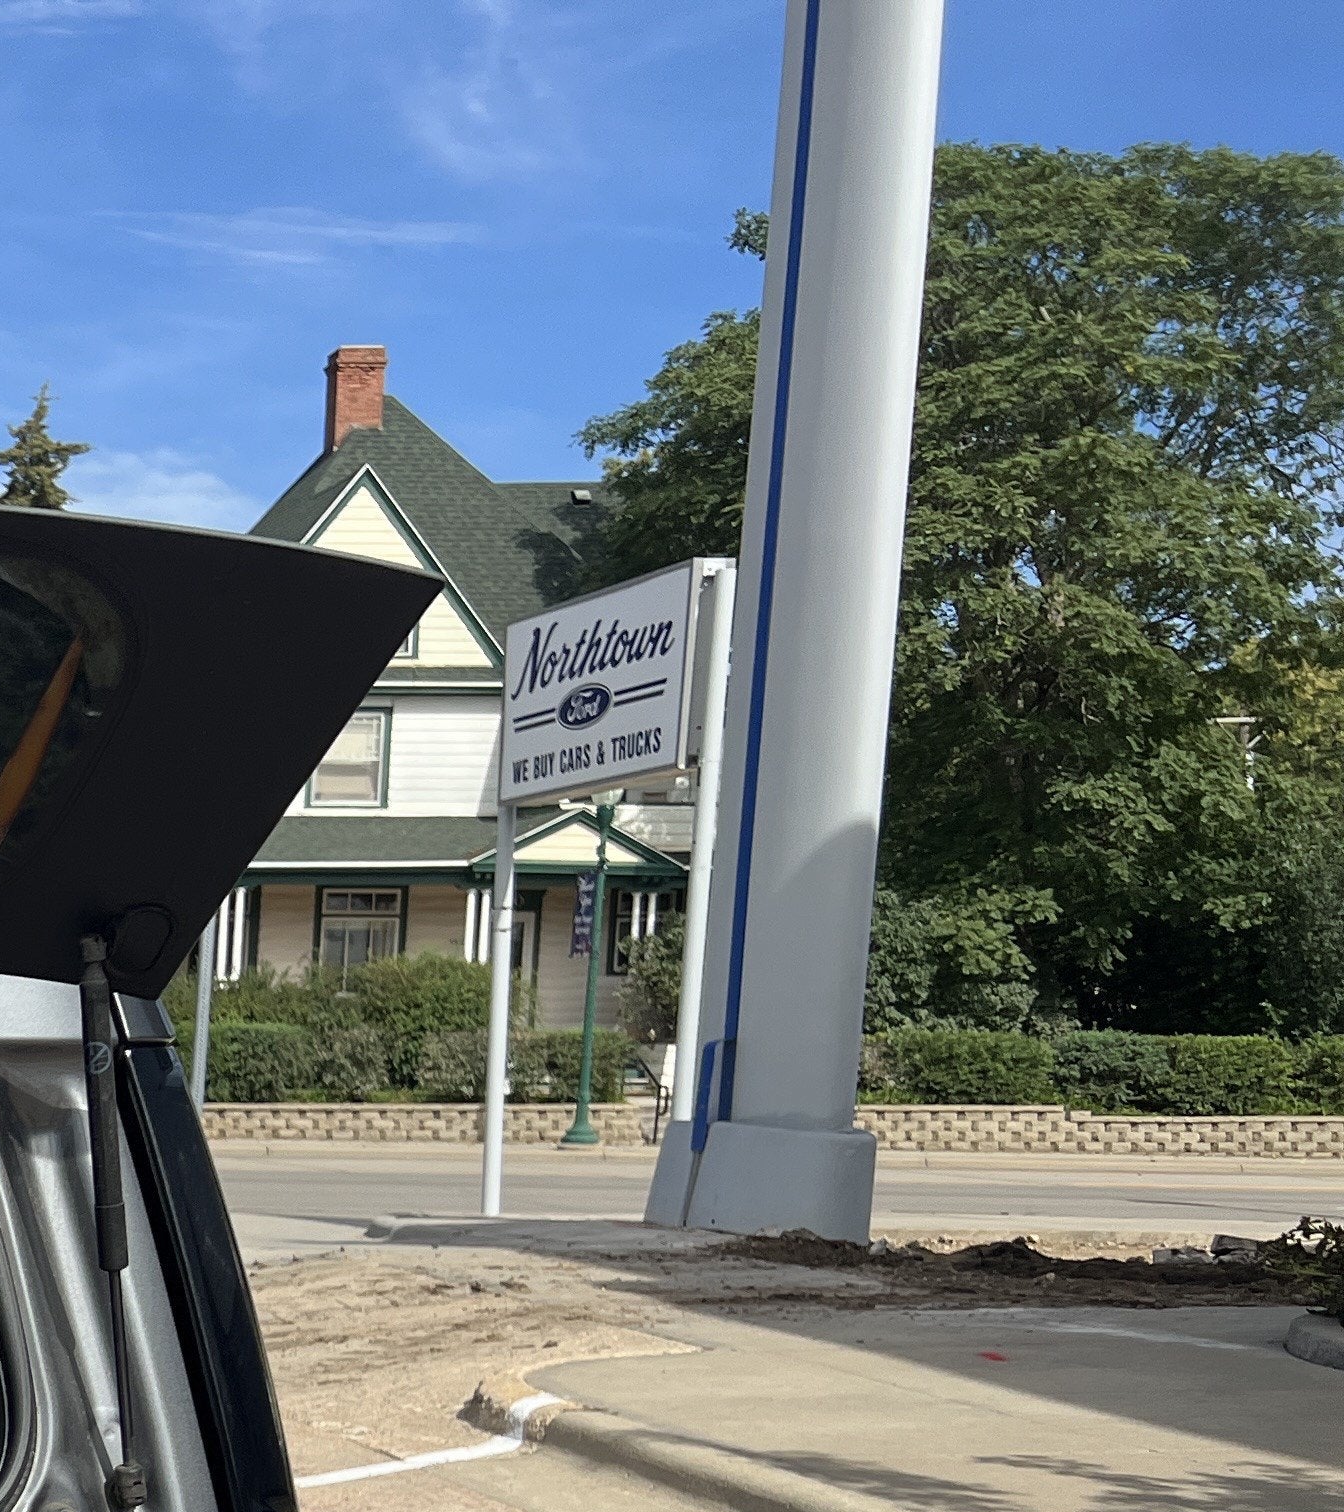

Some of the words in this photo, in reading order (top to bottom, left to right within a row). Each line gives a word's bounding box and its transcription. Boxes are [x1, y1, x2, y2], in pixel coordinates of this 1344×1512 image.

[511, 619, 675, 700] Northtown
[567, 690, 601, 722] Ford
[512, 759, 528, 784] WE
[534, 752, 555, 779] BUY
[559, 743, 591, 773] CARS
[596, 740, 605, 765] &
[611, 727, 662, 762] TRUCKS
